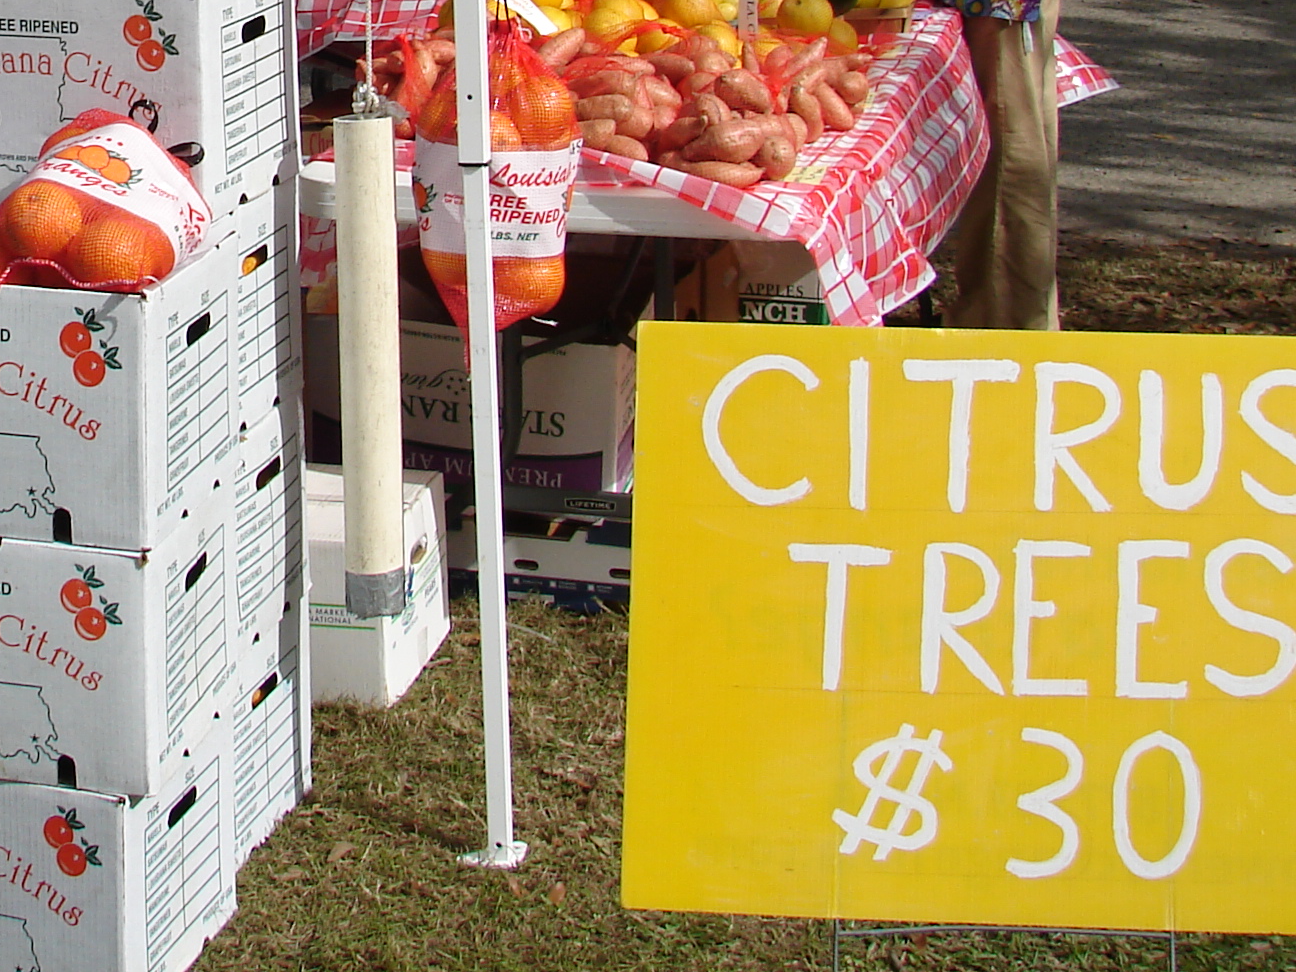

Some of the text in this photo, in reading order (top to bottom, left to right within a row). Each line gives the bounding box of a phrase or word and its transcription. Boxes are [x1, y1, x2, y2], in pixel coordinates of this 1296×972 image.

[19, 19, 79, 34] RIPENED
[37, 159, 128, 197] ranges
[490, 163, 569, 188] Louisia
[490, 193, 527, 210] REE
[490, 208, 560, 224] RIPENED
[516, 233, 540, 241] NET
[745, 282, 804, 299] APPLES
[742, 302, 807, 323] NCH
[702, 354, 1296, 515] CITRUS
[309, 616, 351, 624] NATIONAL
[788, 538, 1296, 699] TREES
